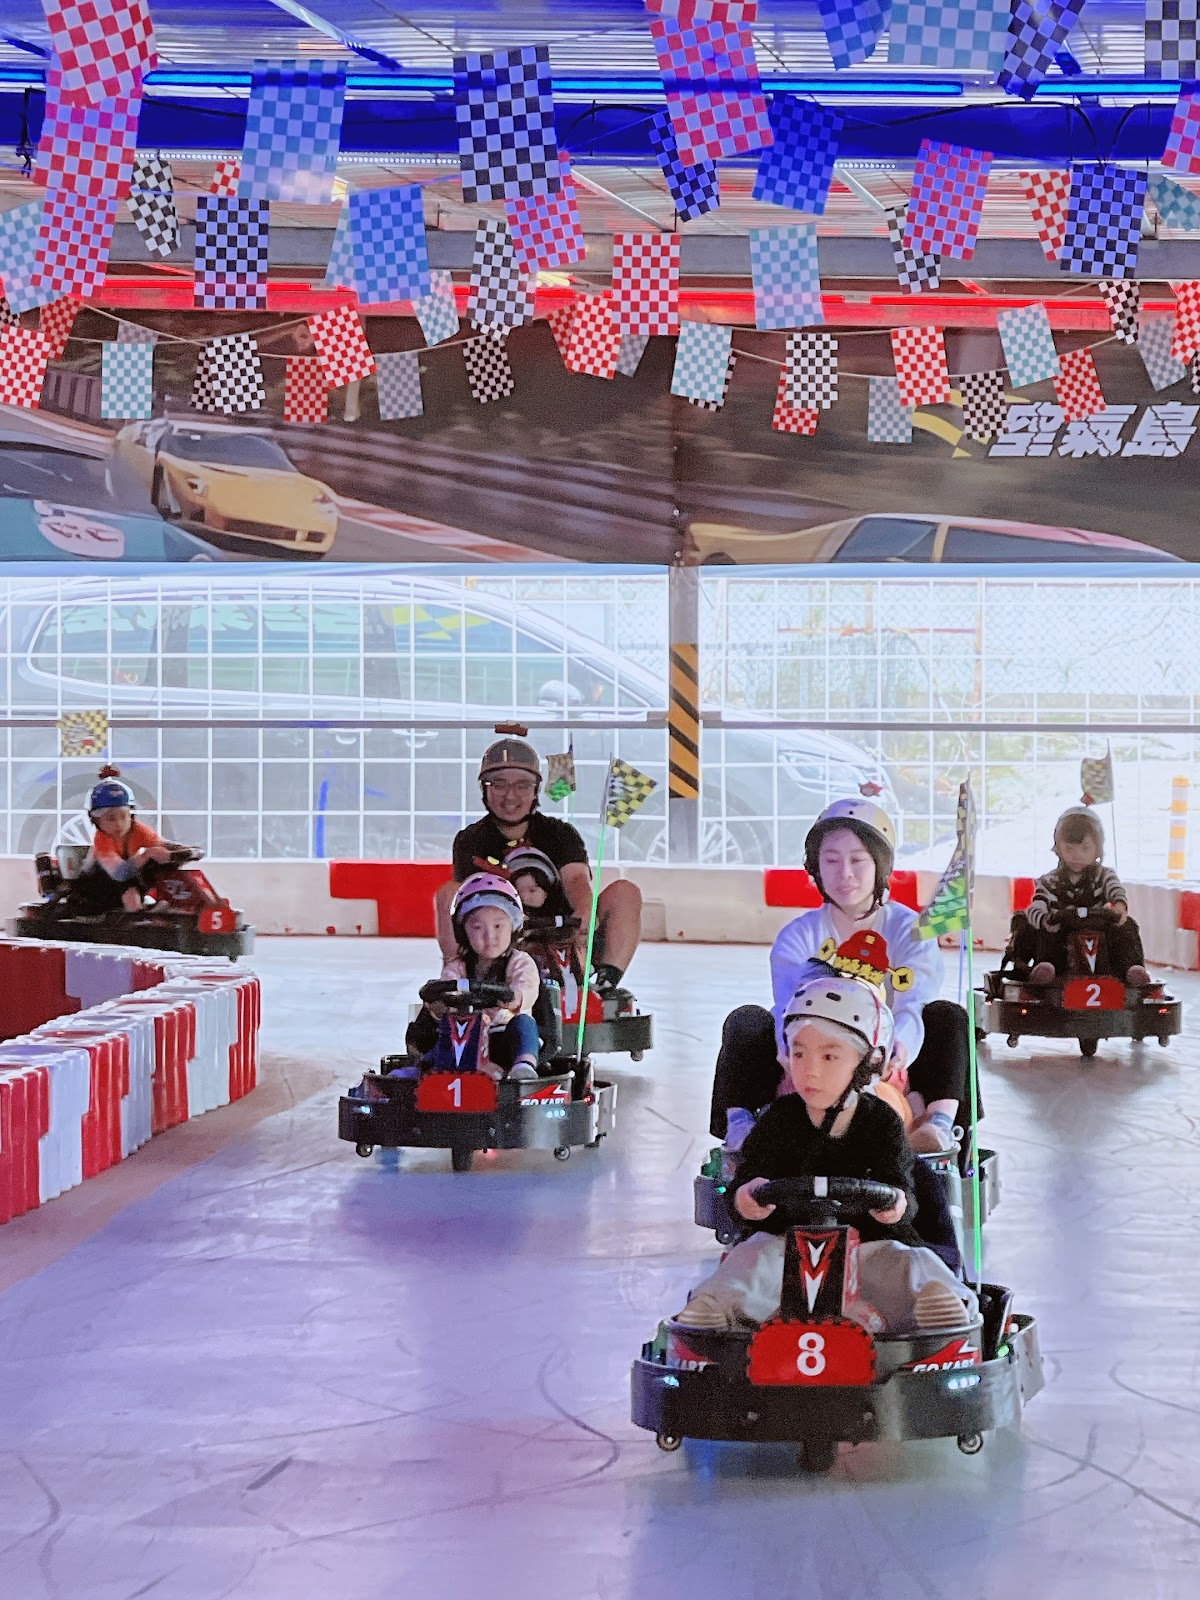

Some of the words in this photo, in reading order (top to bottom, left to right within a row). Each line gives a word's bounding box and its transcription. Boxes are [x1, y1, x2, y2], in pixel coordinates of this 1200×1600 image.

[988, 401, 1200, 458] 空氣島
[211, 911, 223, 930] 5
[1086, 983, 1101, 1007] 2
[447, 1078, 461, 1107] 1
[796, 1331, 826, 1377] 8
